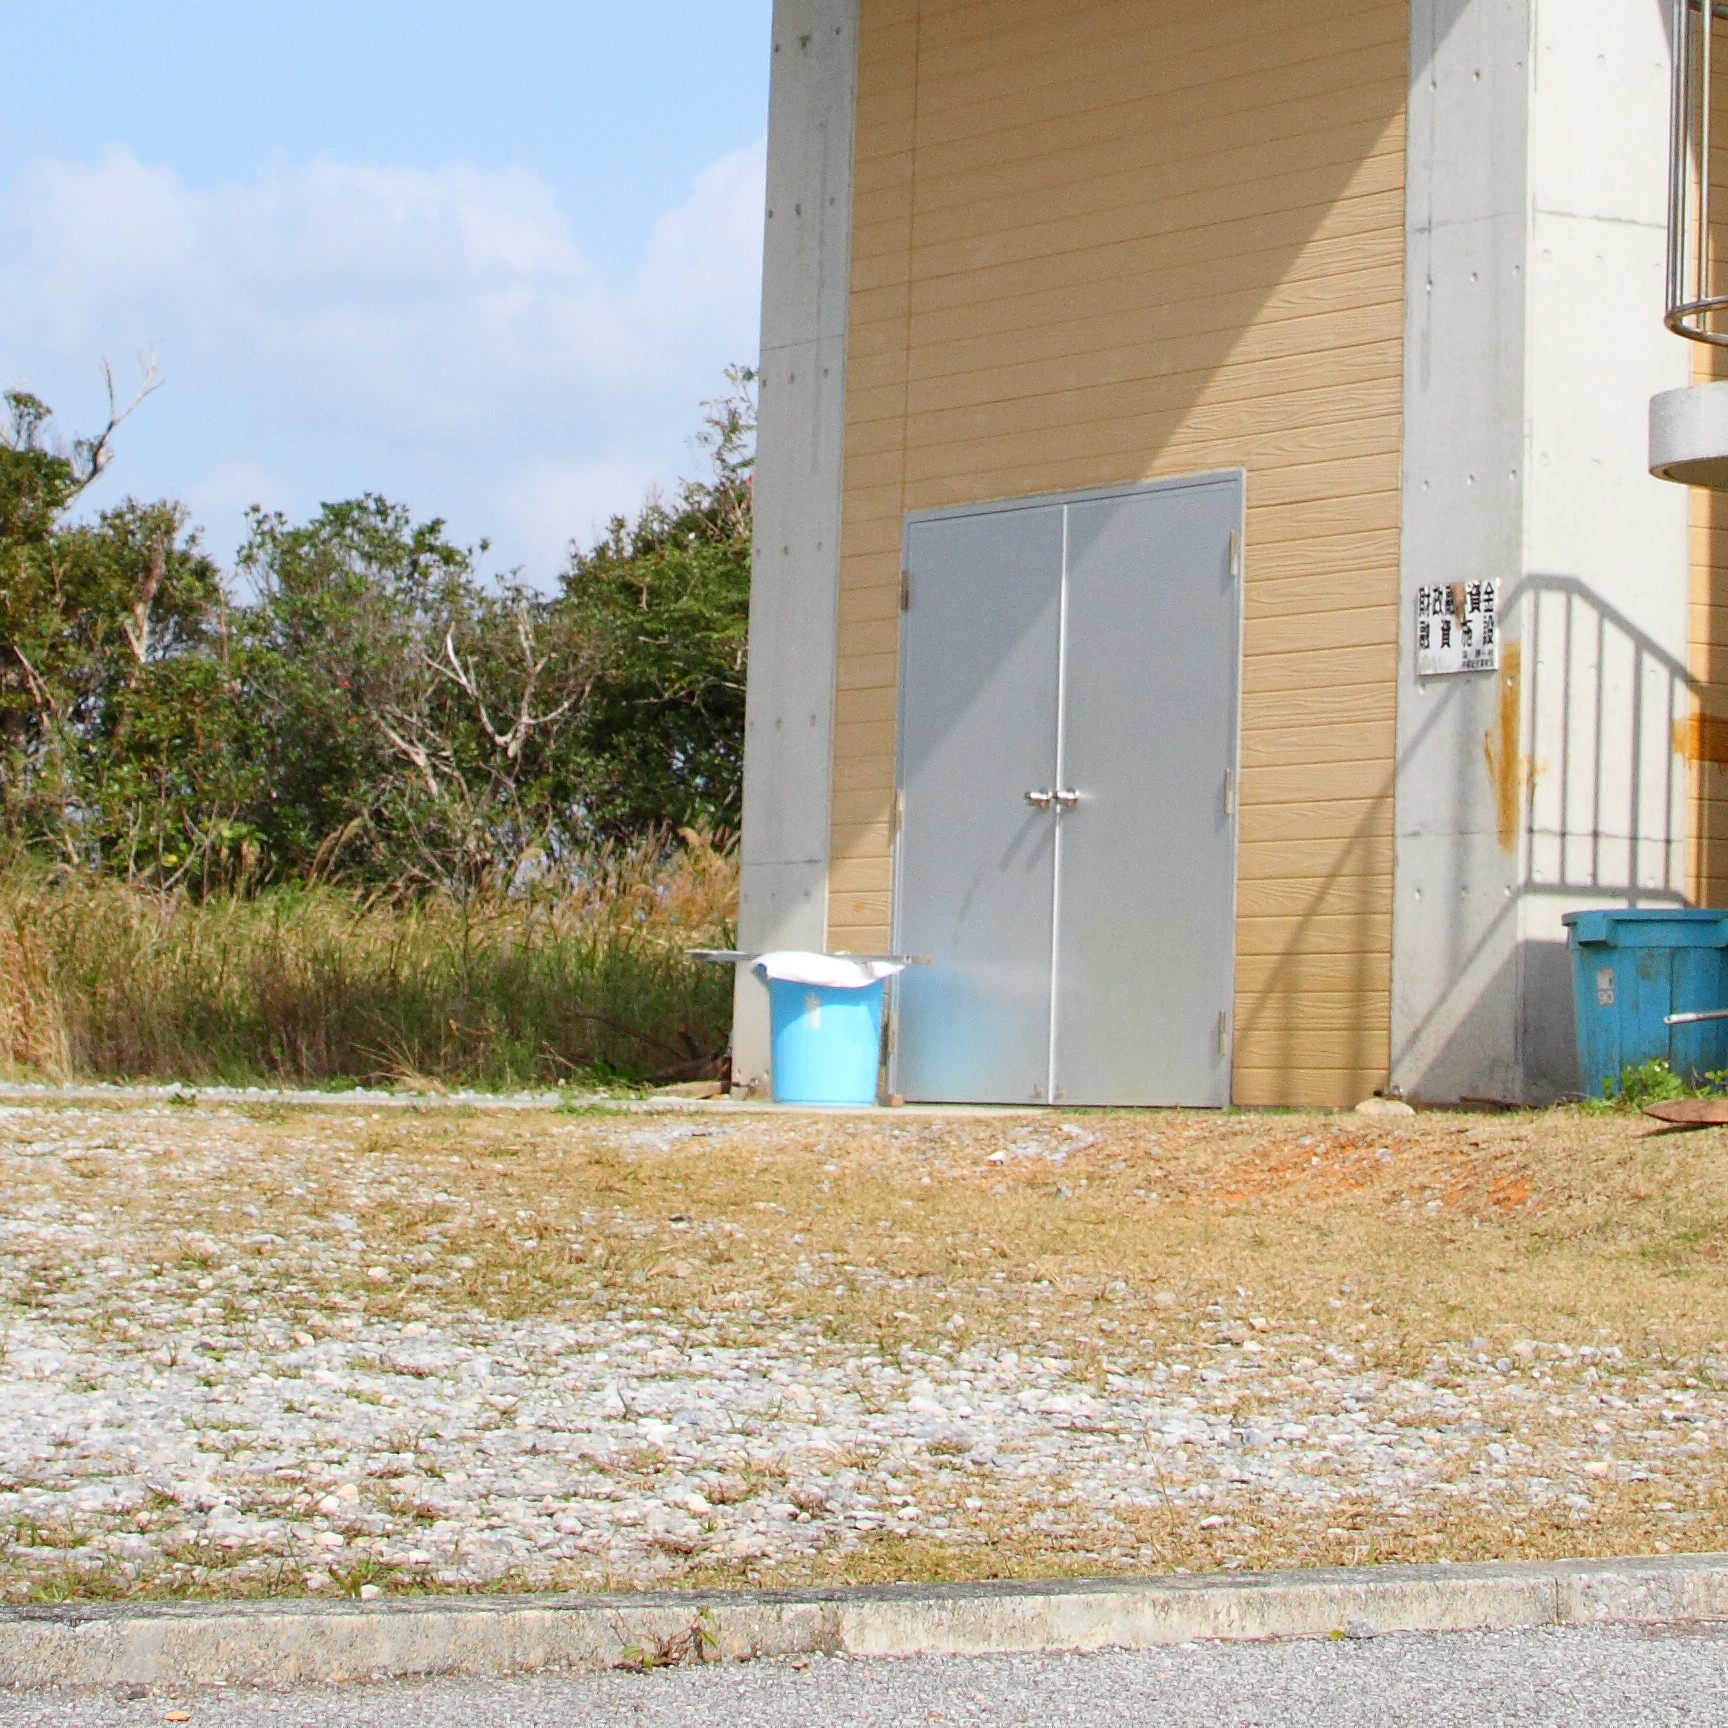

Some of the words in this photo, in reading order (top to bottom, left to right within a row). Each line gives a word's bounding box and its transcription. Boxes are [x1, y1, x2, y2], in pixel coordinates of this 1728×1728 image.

[1418, 581, 1495, 617] 財政融資金
